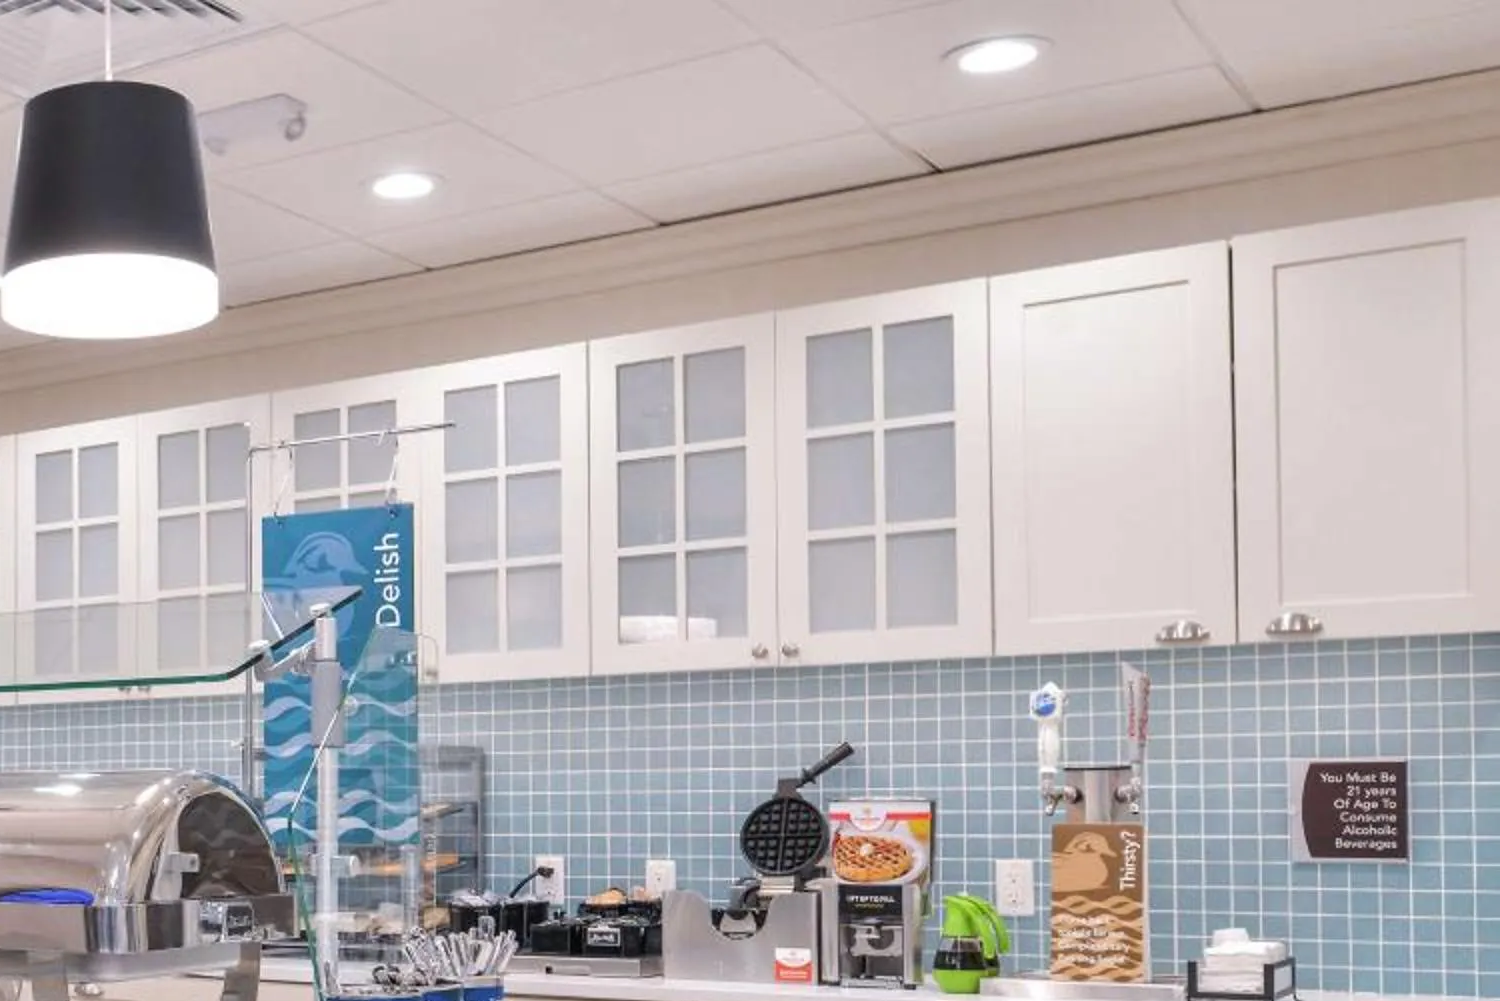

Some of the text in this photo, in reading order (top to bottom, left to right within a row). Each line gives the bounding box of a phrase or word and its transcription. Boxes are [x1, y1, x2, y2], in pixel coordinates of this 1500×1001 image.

[373, 532, 401, 627] Delish
[1319, 771, 1397, 783] You Must Be
[1346, 785, 1397, 799] 21 years
[1333, 797, 1397, 812] Of Age To
[1340, 811, 1397, 823] Consume
[1341, 824, 1397, 836] Alcoholic
[1335, 837, 1398, 851] Beverages
[1119, 829, 1141, 891] Thirsty?
